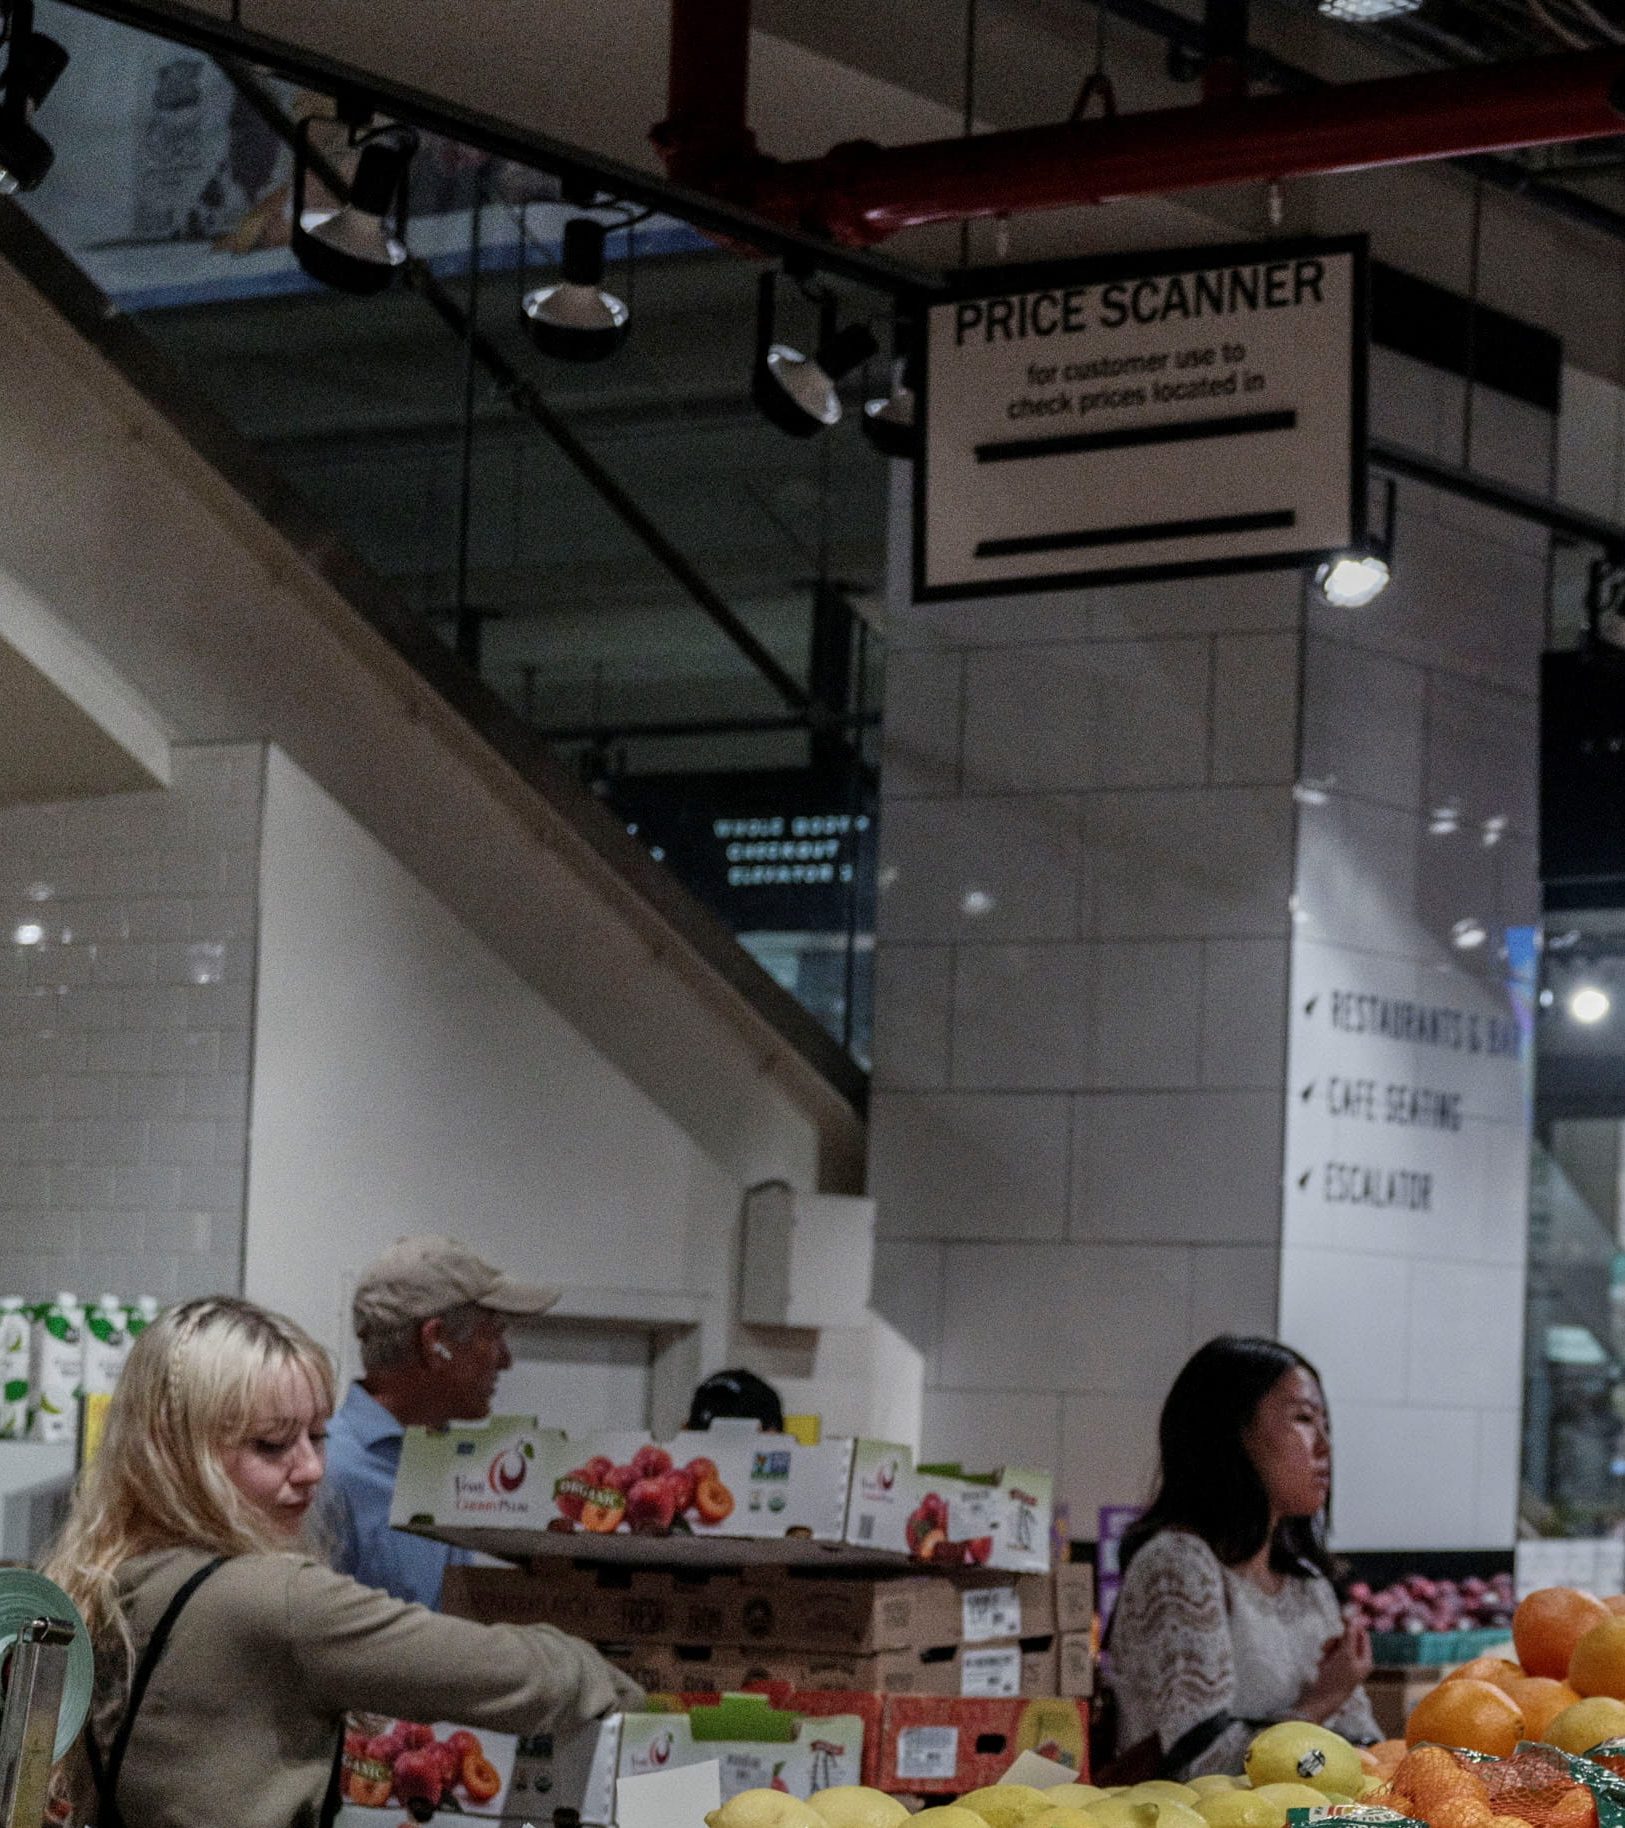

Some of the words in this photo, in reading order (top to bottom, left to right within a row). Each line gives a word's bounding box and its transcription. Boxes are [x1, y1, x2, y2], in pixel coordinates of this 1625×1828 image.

[955, 288, 1087, 346] PRICE
[1100, 260, 1325, 328] SCANNER
[1027, 362, 1057, 385] for
[1063, 351, 1170, 382] customer
[1174, 349, 1216, 372] use
[1221, 342, 1246, 364] to
[1006, 394, 1073, 420] check
[1078, 386, 1146, 416] prices
[1151, 374, 1238, 404] located
[1243, 371, 1266, 394] in
